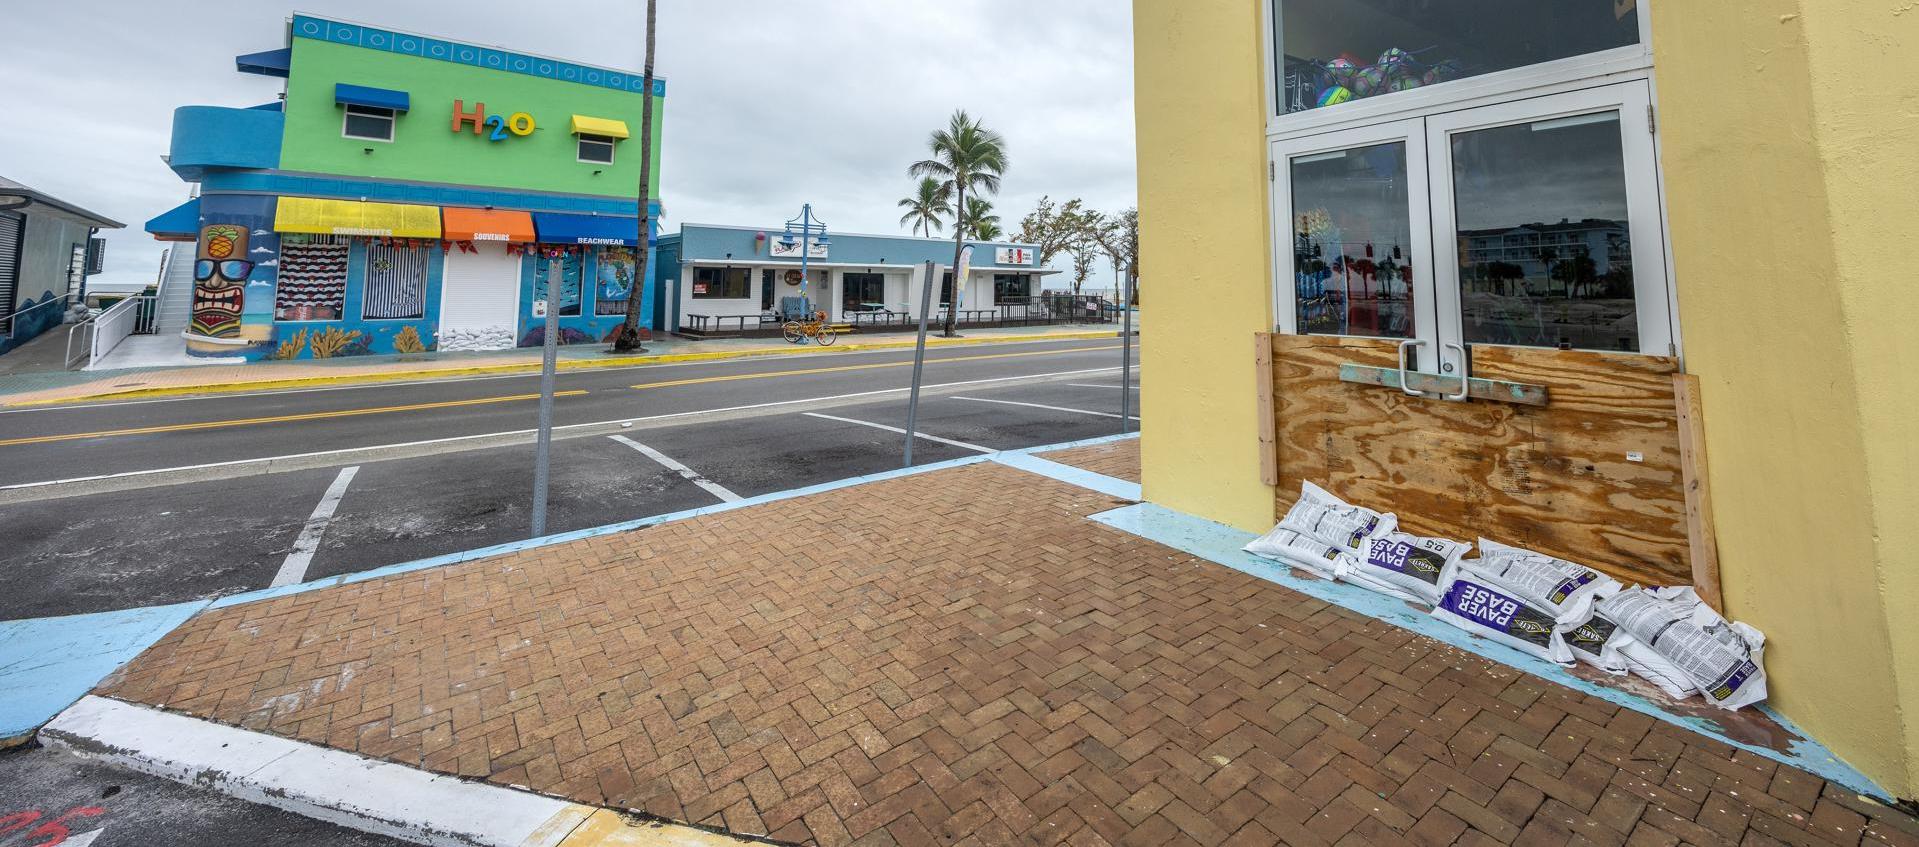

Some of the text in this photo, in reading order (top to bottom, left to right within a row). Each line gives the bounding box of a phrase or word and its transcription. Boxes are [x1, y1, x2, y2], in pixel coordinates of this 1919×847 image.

[452, 99, 536, 141] H2O
[332, 227, 393, 236] SWIMSUITS
[473, 232, 510, 241] SOUVENIRS
[577, 237, 625, 246] BEACHWEAR
[1424, 539, 1445, 552] 0.5
[1369, 549, 1405, 568] PAVE
[1461, 585, 1519, 616] BASE
[1458, 598, 1511, 626] PAVER
[1574, 626, 1601, 641] SAKRE
